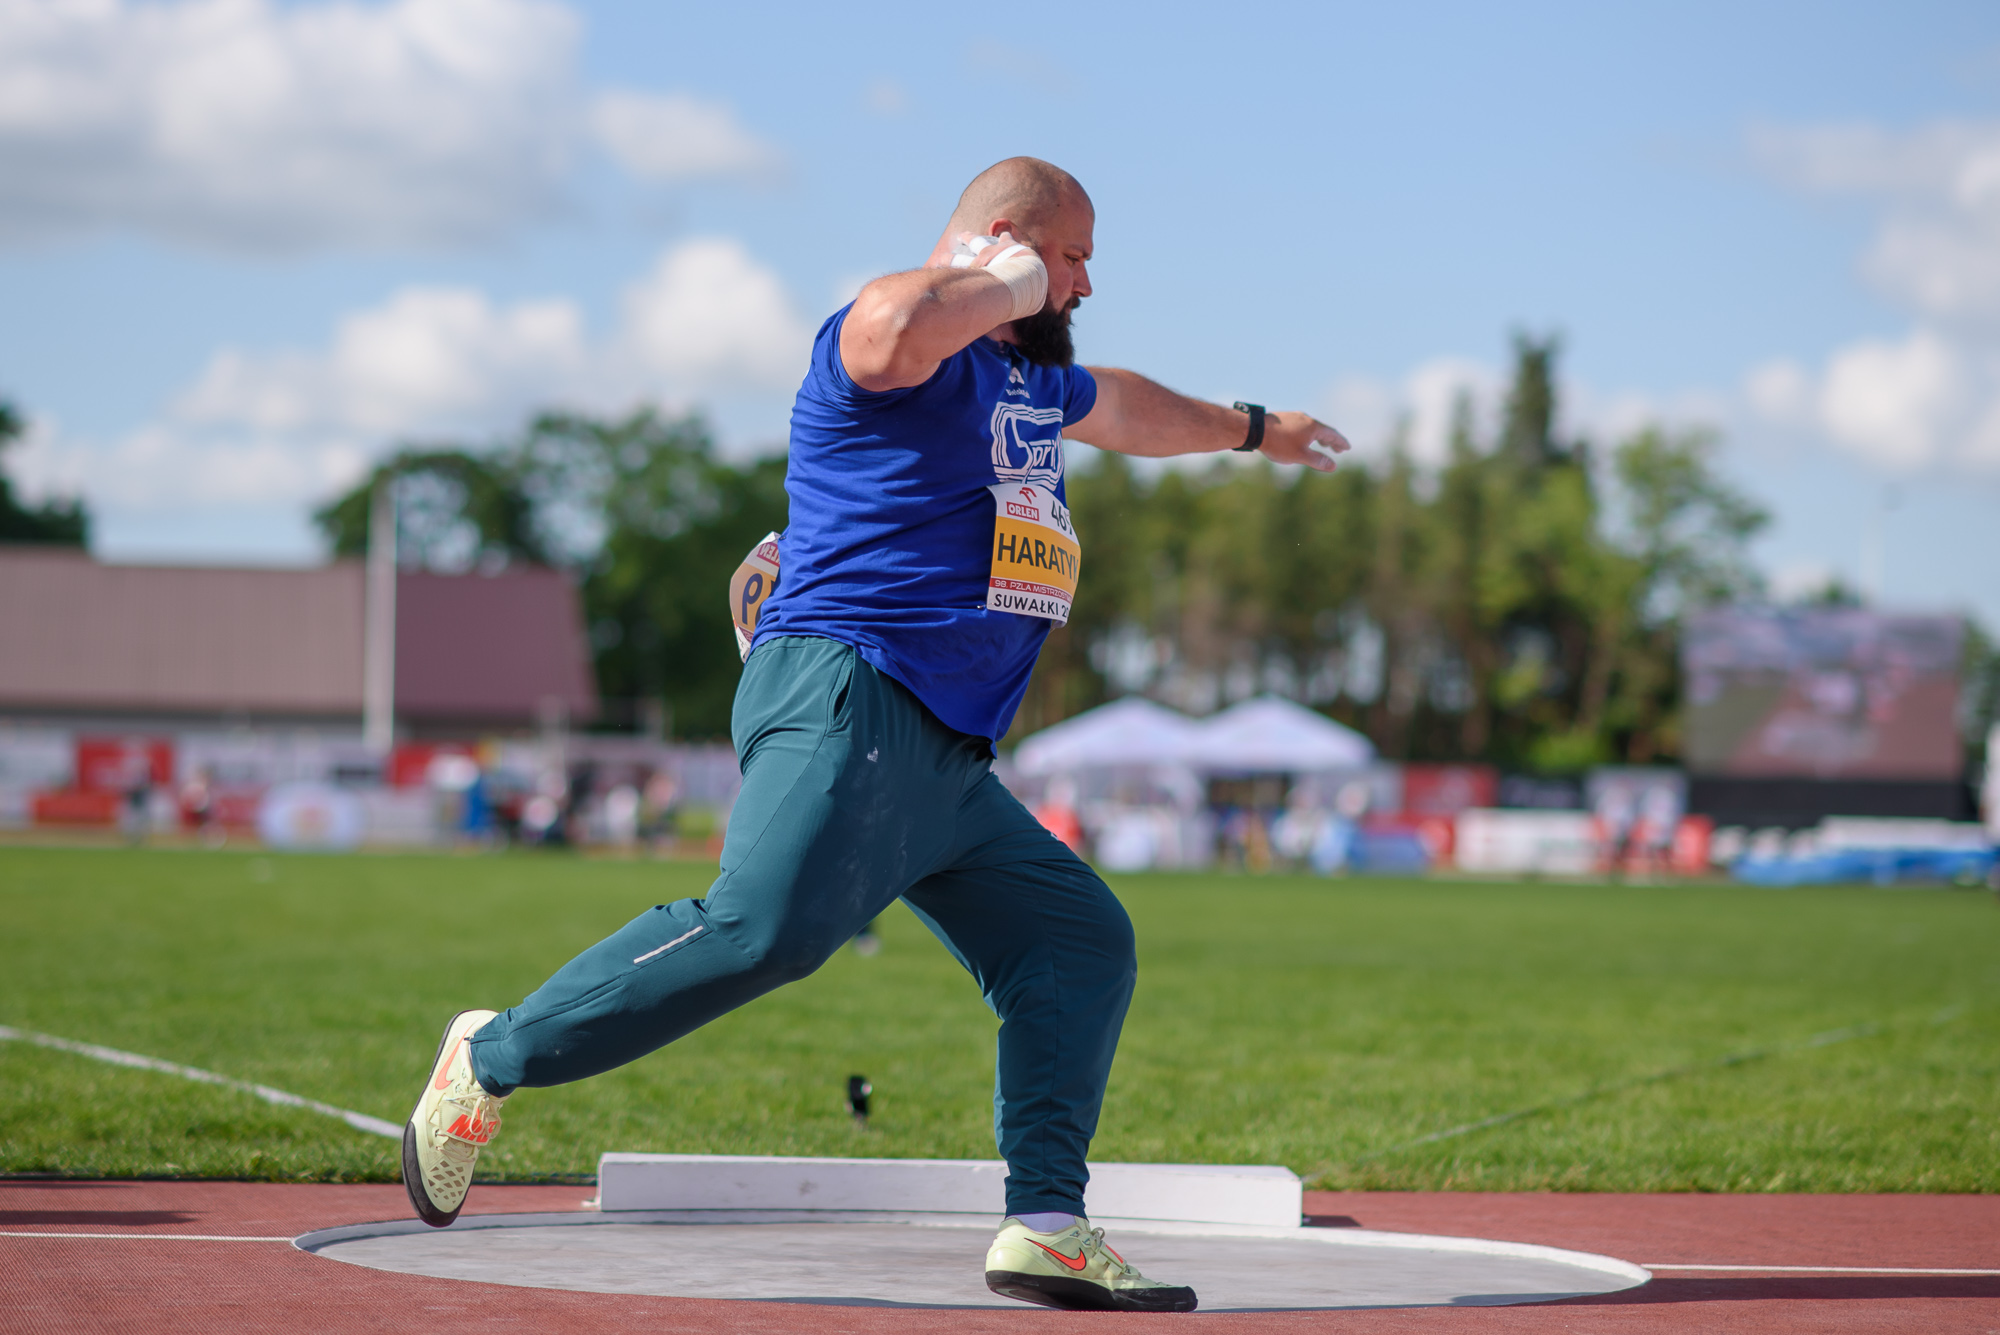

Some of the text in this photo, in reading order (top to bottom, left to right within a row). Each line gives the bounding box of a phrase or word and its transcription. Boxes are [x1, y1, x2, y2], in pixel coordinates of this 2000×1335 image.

[1008, 504, 1039, 520] ORLEN
[1010, 582, 1032, 592] PZLA
[993, 593, 1059, 616] SUWAŁKI
